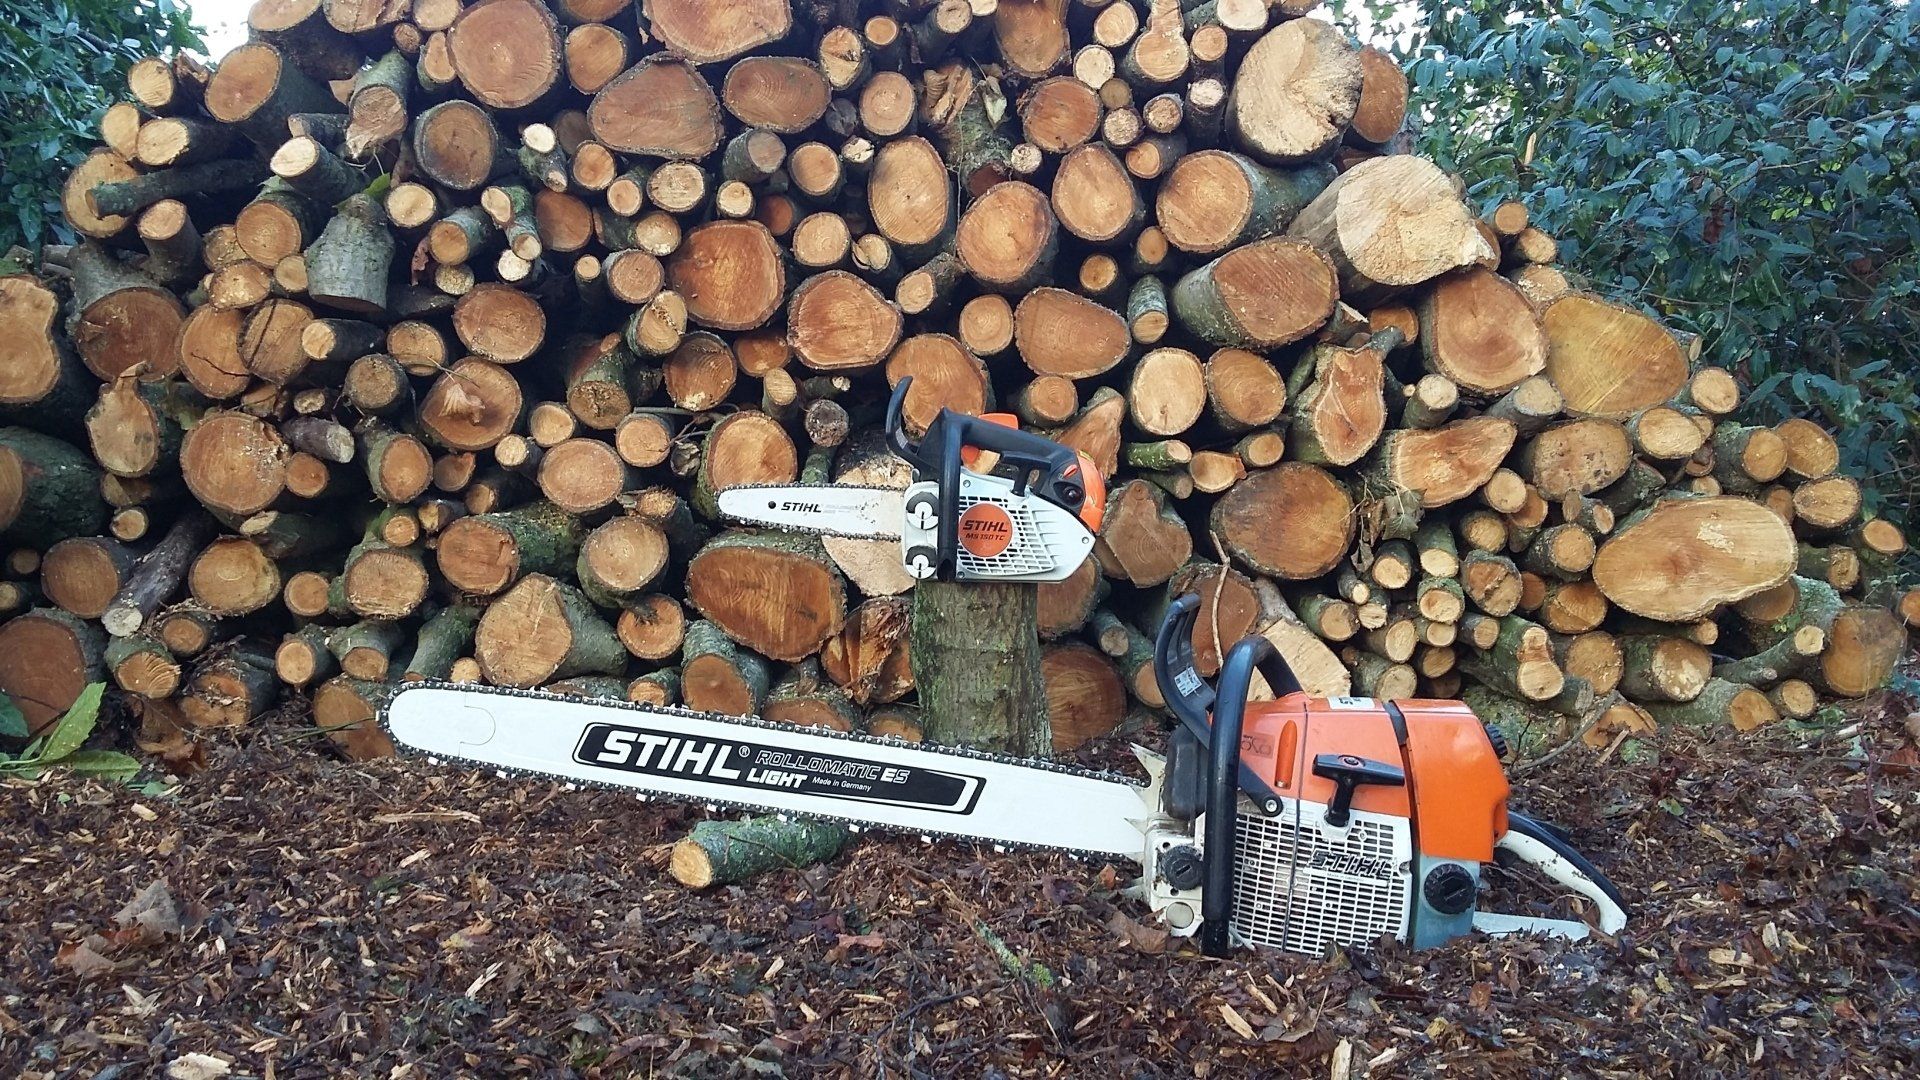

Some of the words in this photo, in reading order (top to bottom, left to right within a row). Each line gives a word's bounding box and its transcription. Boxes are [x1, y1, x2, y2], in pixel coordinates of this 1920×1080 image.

[781, 502, 822, 513] STIHL
[963, 520, 1008, 533] STIHL
[746, 767, 808, 789] LIGHT
[812, 776, 832, 785] Made
[833, 778, 840, 787] in
[840, 779, 872, 792] Germany
[755, 750, 880, 780] ROLLOMATIC
[880, 767, 910, 784] ES
[1309, 849, 1391, 880] STIHL
